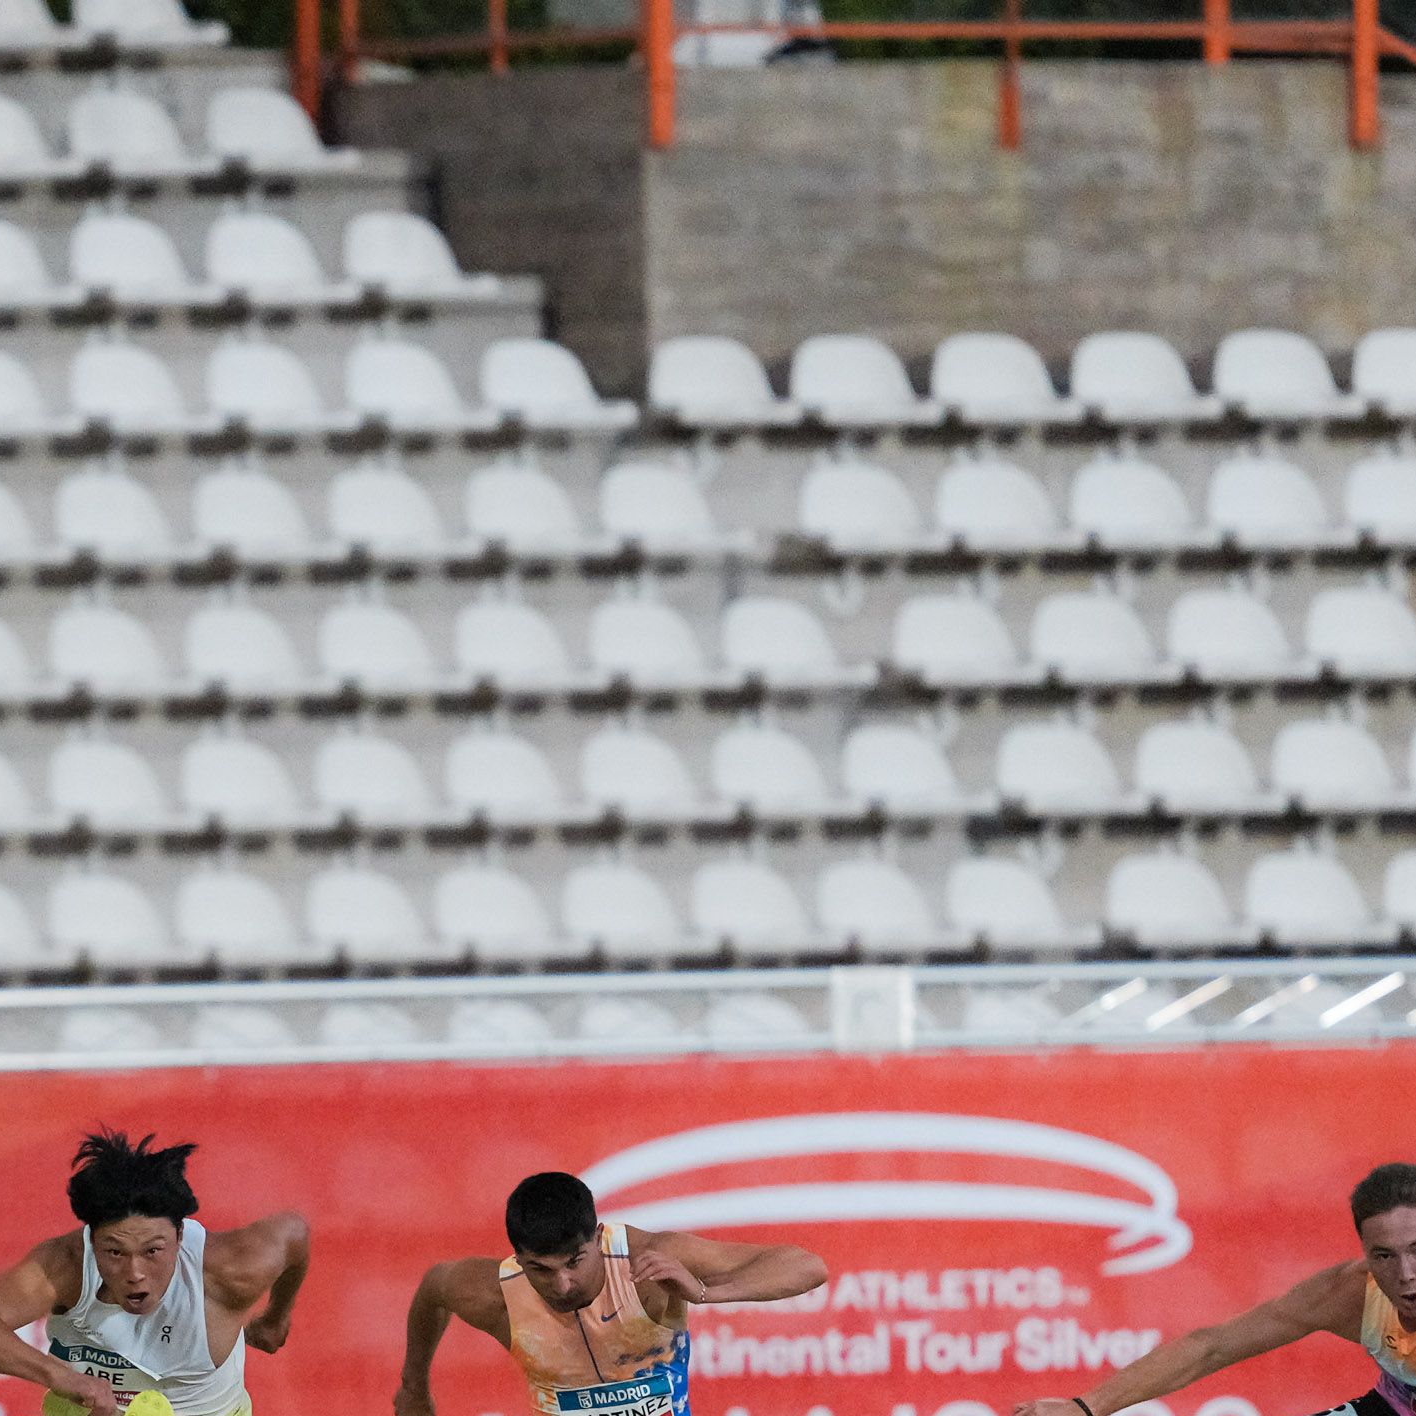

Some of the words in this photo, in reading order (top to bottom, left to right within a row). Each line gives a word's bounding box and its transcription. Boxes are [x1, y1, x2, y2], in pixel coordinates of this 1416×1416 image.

[834, 1268, 1062, 1310] ATHLETICS
[895, 1320, 1009, 1373] Tour
[1015, 1315, 1160, 1371] Silver
[85, 1350, 132, 1367] MADR
[84, 1366, 124, 1386] ABE
[594, 1384, 651, 1405] MADRID
